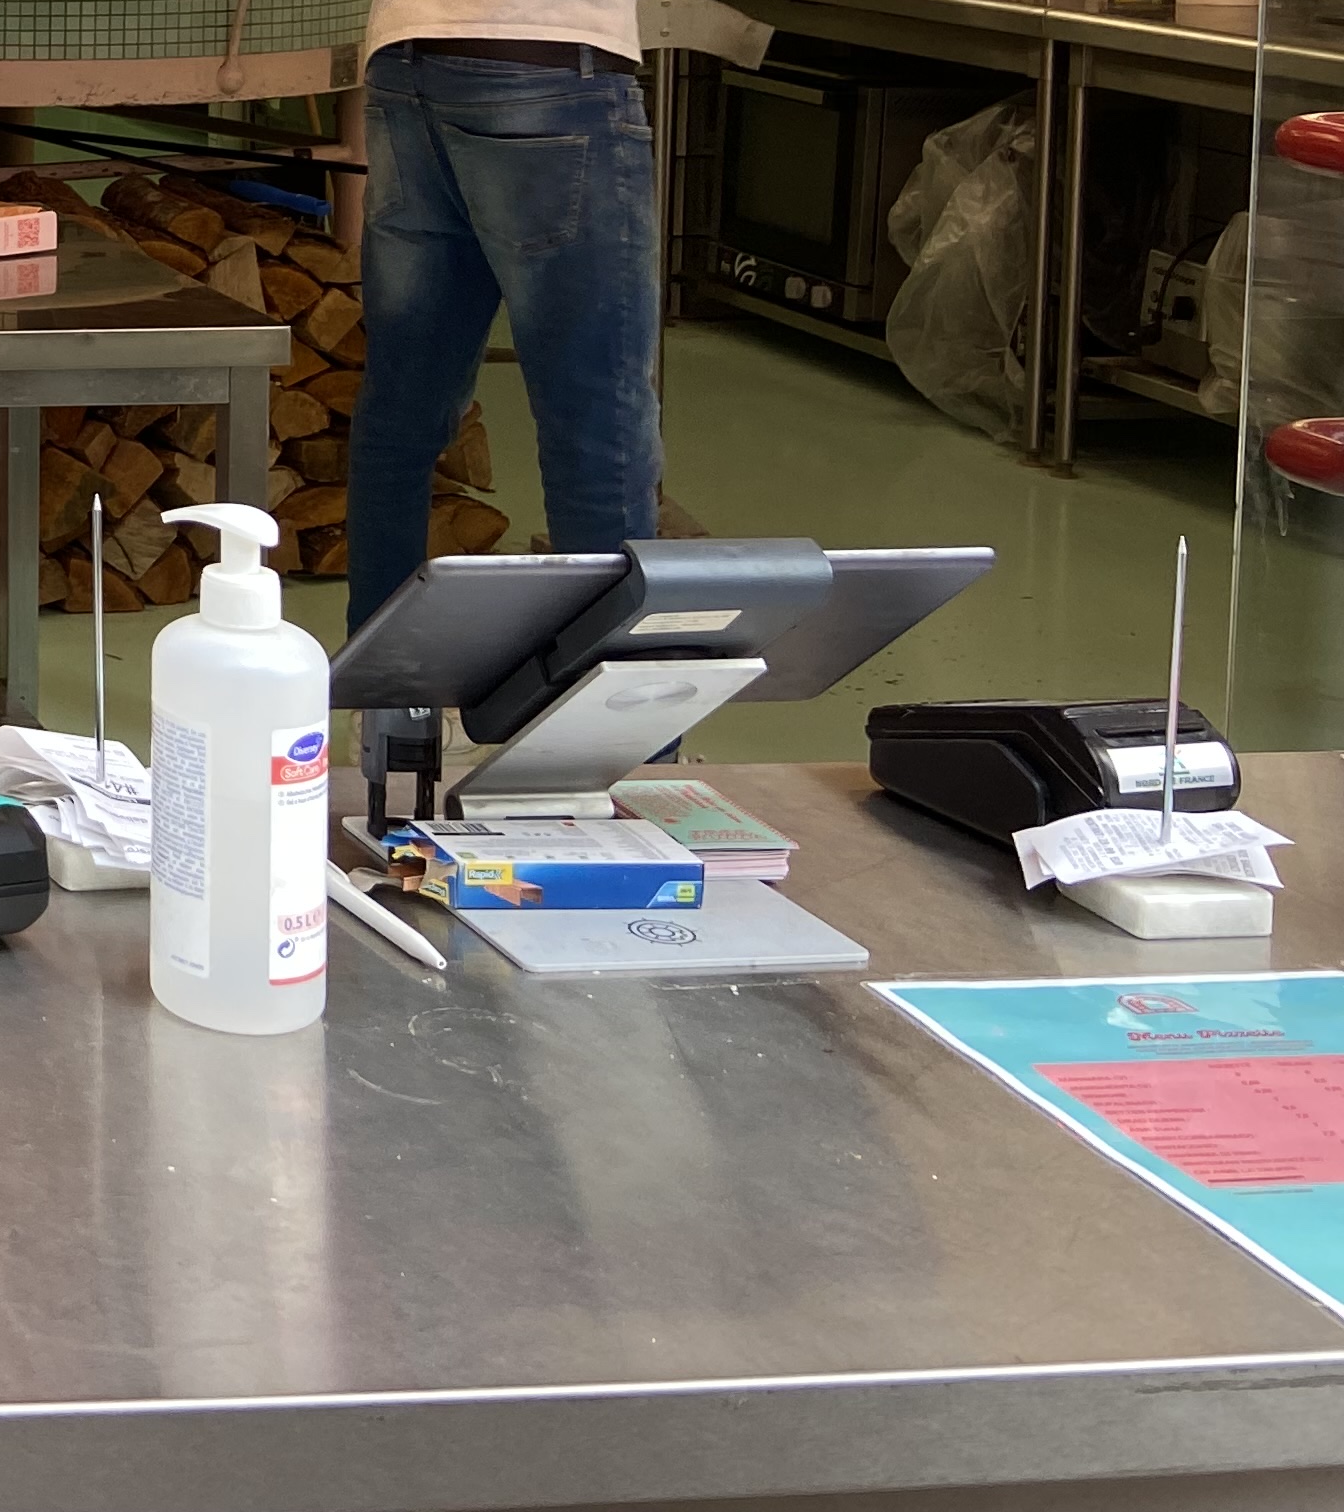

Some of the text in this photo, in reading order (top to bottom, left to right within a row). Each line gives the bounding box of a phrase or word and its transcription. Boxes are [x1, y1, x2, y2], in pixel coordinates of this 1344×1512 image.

[284, 766, 303, 779] Soft
[1179, 775, 1215, 785] FRANCE
[468, 869, 493, 880] Rapid
[284, 916, 303, 931] 0.5
